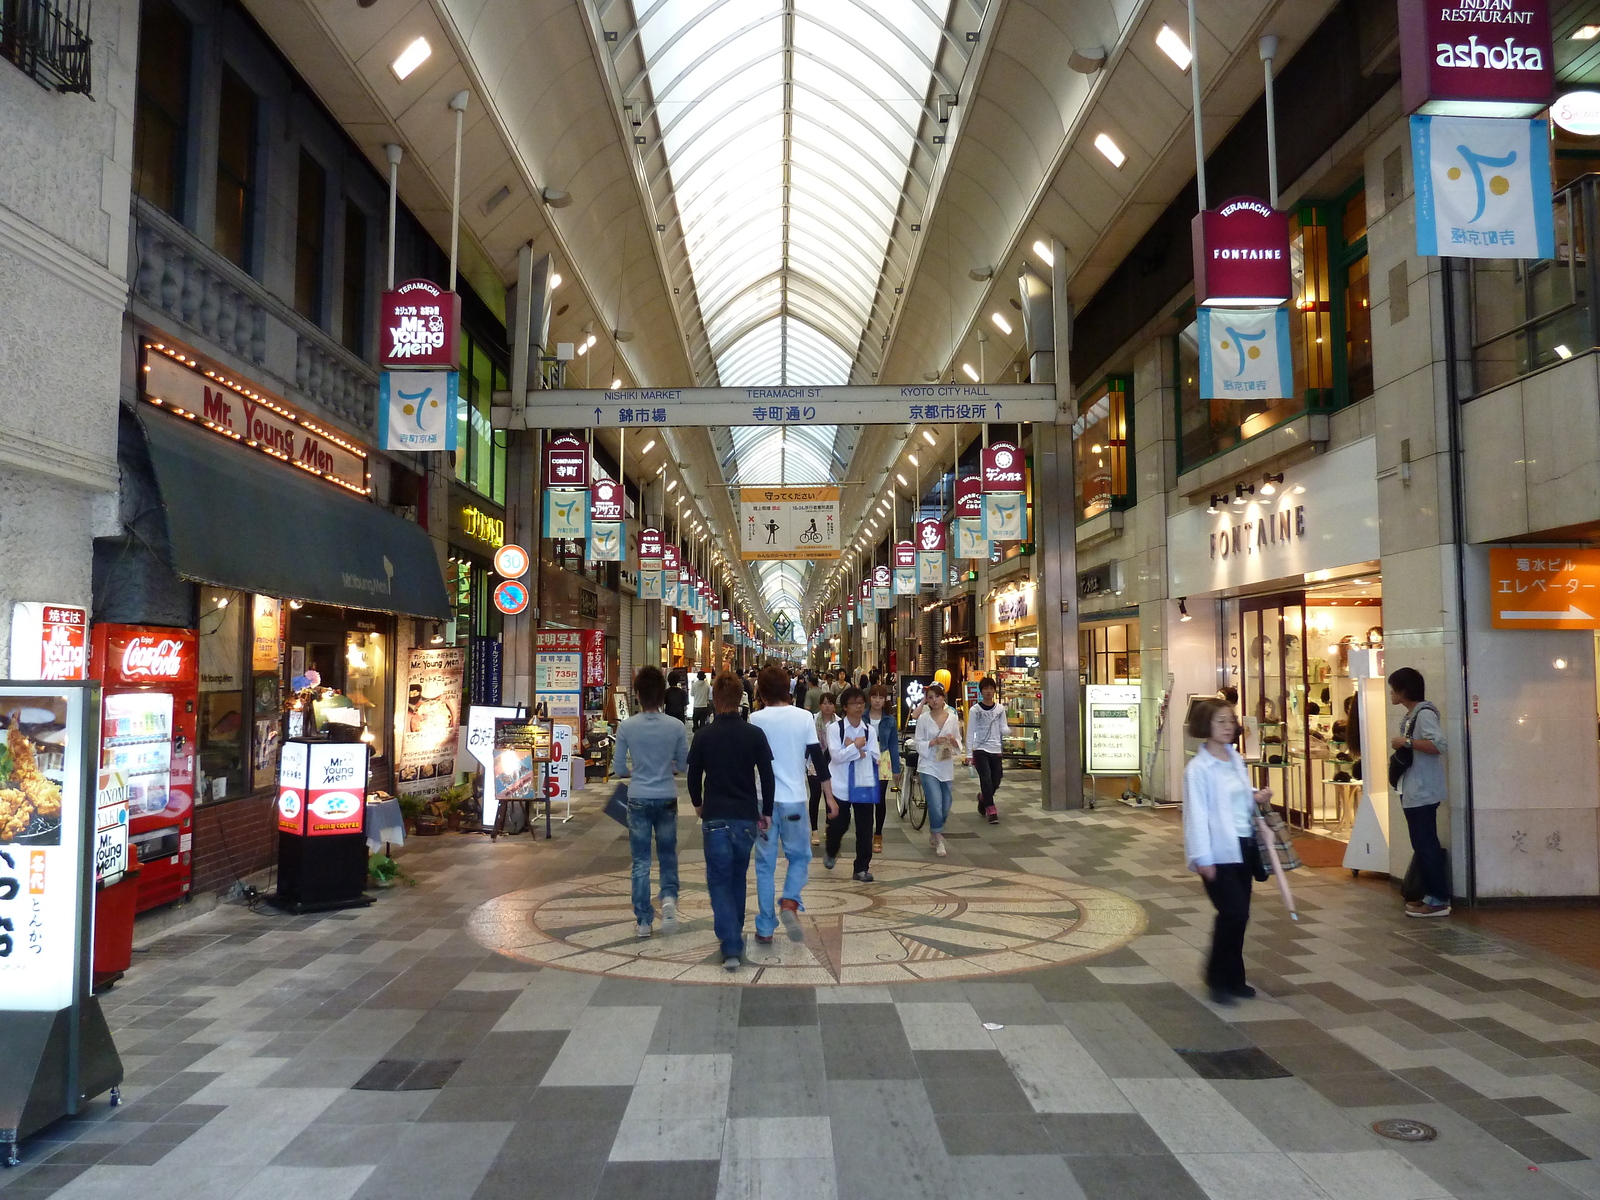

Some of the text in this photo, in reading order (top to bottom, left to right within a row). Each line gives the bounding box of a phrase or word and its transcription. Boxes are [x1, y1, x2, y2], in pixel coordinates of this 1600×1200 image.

[1459, 0, 1512, 10] INDIAN
[1441, 9, 1534, 24] RESTAURANT
[1436, 36, 1543, 70] ashoka
[1220, 202, 1271, 218] TERAMACHI
[1213, 249, 1281, 260] FONTAINE
[398, 282, 440, 297] TERAMACHI
[401, 317, 425, 332] Mr.
[390, 328, 444, 348] Young
[388, 343, 432, 358] Men
[604, 390, 682, 400] NISHIKI MARKET
[746, 389, 823, 398] TERAMACHI ST.
[900, 387, 990, 397] KYOTO CITY HALL
[618, 407, 667, 423] 錦市場
[752, 406, 816, 421] 寺町通り
[909, 404, 987, 420] 京都市役所
[203, 385, 334, 473] Mr. Young Men
[1210, 505, 1305, 560] FONTAINE
[503, 554, 521, 569] 30
[1516, 558, 1576, 572] 菊水ビル
[1497, 579, 1596, 594] エレベーター
[43, 640, 84, 667] Young
[122, 637, 184, 676] Coca-Cola
[42, 661, 75, 680] Men
[423, 660, 443, 669] Young
[444, 659, 460, 669] Men
[555, 670, 578, 678] 735円
[470, 726, 494, 746] お好
[323, 766, 354, 777] Young
[322, 775, 347, 784] Men
[336, 821, 360, 830] COFFEE
[30, 854, 45, 889] 名代
[29, 897, 43, 954] とんかつ
